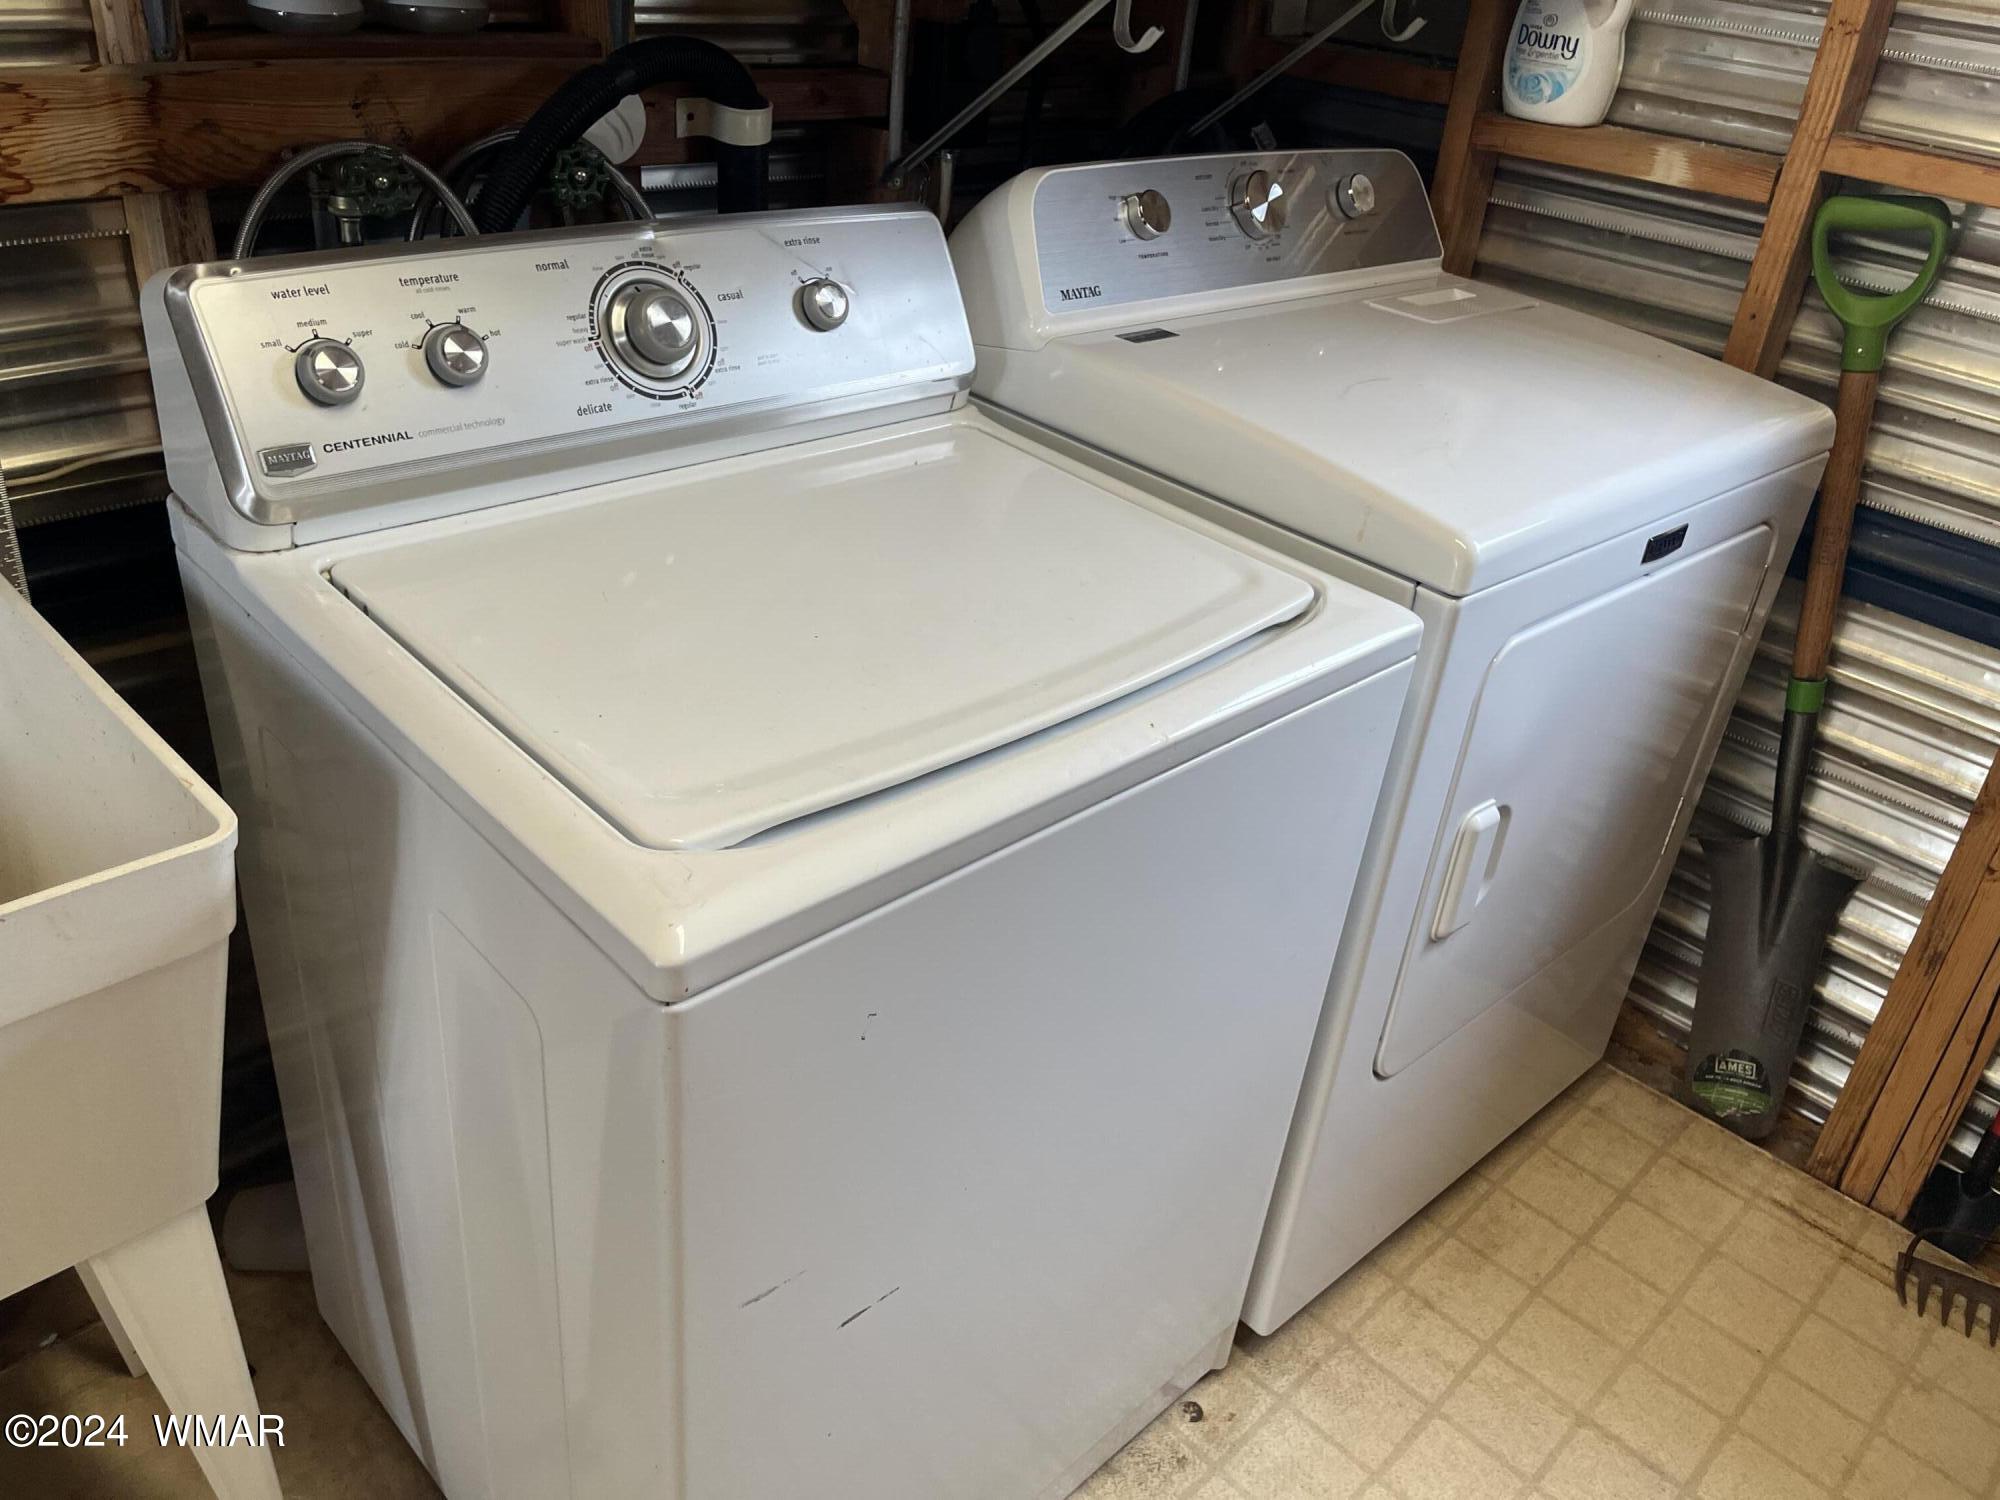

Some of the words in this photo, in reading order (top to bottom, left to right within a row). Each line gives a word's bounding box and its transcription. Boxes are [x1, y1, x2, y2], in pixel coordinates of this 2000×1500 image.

[1517, 23, 1580, 61] Downy
[784, 237, 802, 247] extra
[803, 236, 821, 245] rinse
[535, 259, 570, 273] normal
[399, 272, 460, 288] temperature
[271, 286, 301, 300] water
[304, 283, 331, 297] level
[717, 289, 744, 302] casual
[1060, 285, 1102, 302] MAYTAG
[410, 311, 426, 320] cool
[457, 305, 477, 315] warm
[296, 317, 328, 329] medium
[352, 327, 373, 339] super
[489, 328, 501, 337] hot
[260, 339, 283, 349] small
[394, 340, 410, 349] cold
[576, 401, 613, 417] delicate
[322, 430, 414, 454] CENTENNIAL
[418, 422, 463, 439] commercial
[464, 416, 506, 433] technology
[266, 450, 312, 466] MAYTAG
[1718, 1060, 1752, 1075] AMES
